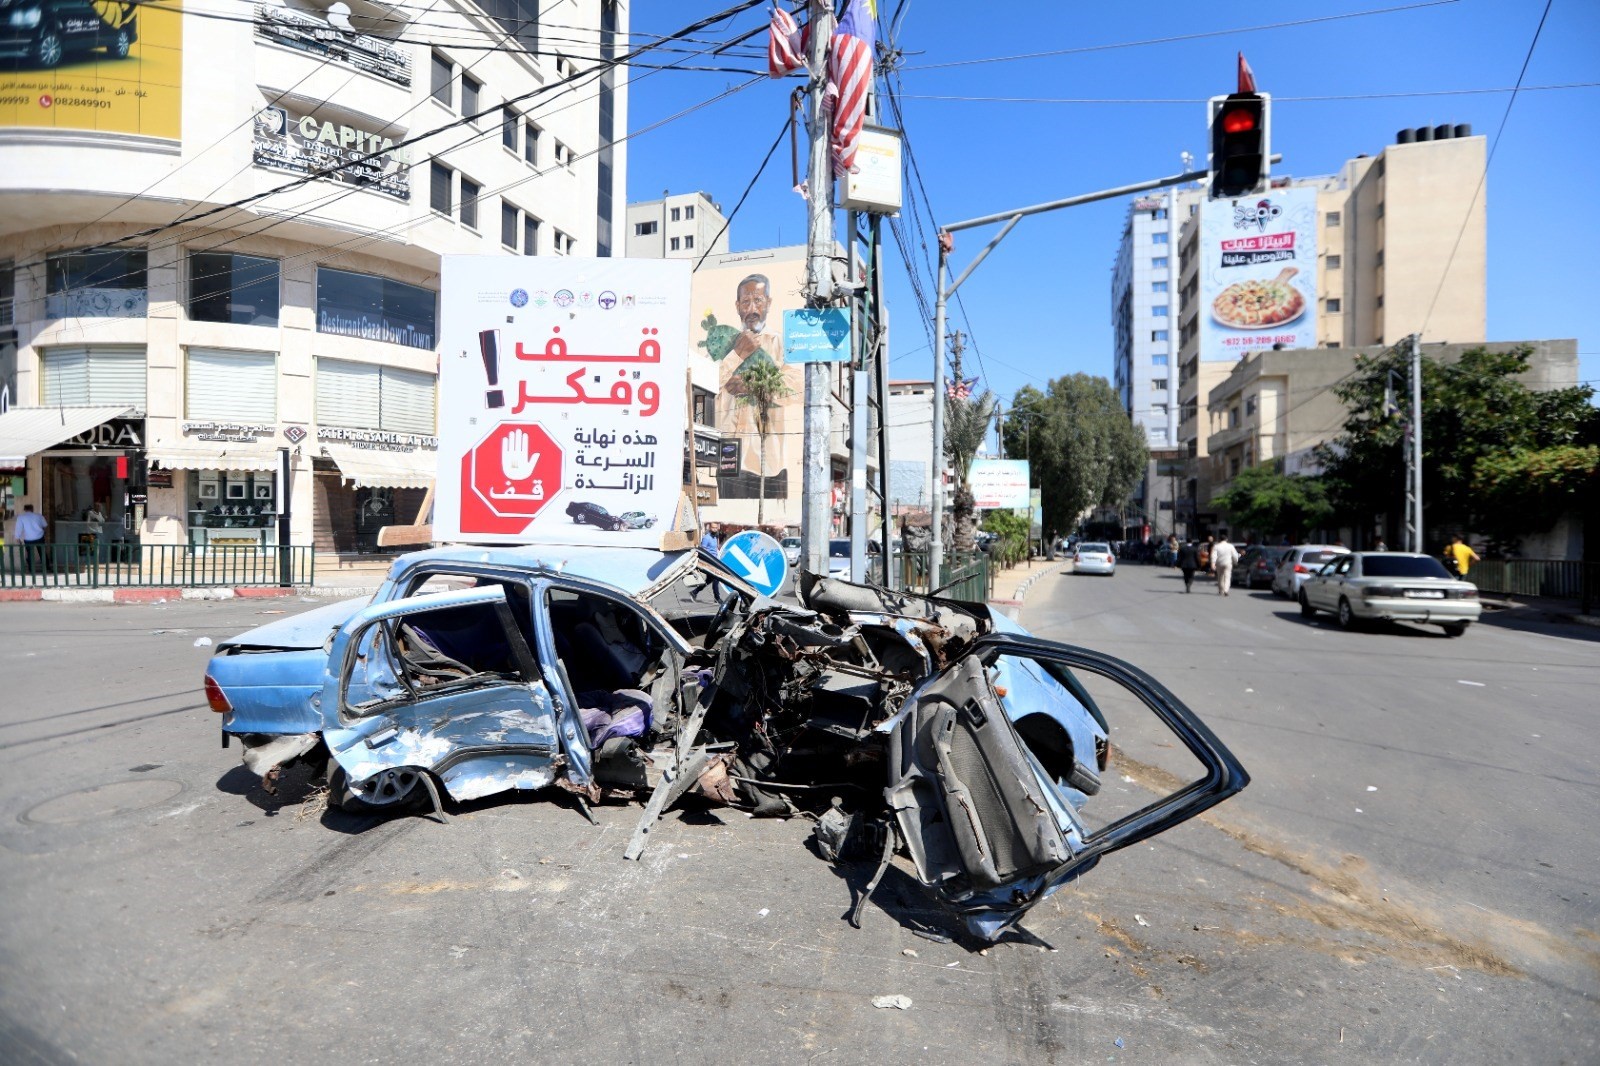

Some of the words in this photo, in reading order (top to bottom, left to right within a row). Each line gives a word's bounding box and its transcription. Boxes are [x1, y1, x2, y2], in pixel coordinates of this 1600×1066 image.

[54, 97, 111, 109] 082849901
[1223, 239, 1257, 249] عليك
[1259, 234, 1292, 248] البيتزا
[1223, 255, 1246, 265] علينا
[1247, 251, 1293, 264] والتوصيل
[321, 310, 361, 337] Resturant
[361, 315, 380, 340] Gaza
[515, 325, 661, 363] قف
[511, 366, 661, 417] وفكر
[67, 423, 141, 445] ODA
[317, 427, 353, 440] SALEM
[369, 431, 402, 444] SAMER
[573, 427, 616, 449] نهاية
[622, 427, 658, 446] هذه
[575, 449, 656, 470] السرعة
[489, 479, 545, 501] قف
[573, 473, 654, 495] الزائدة
